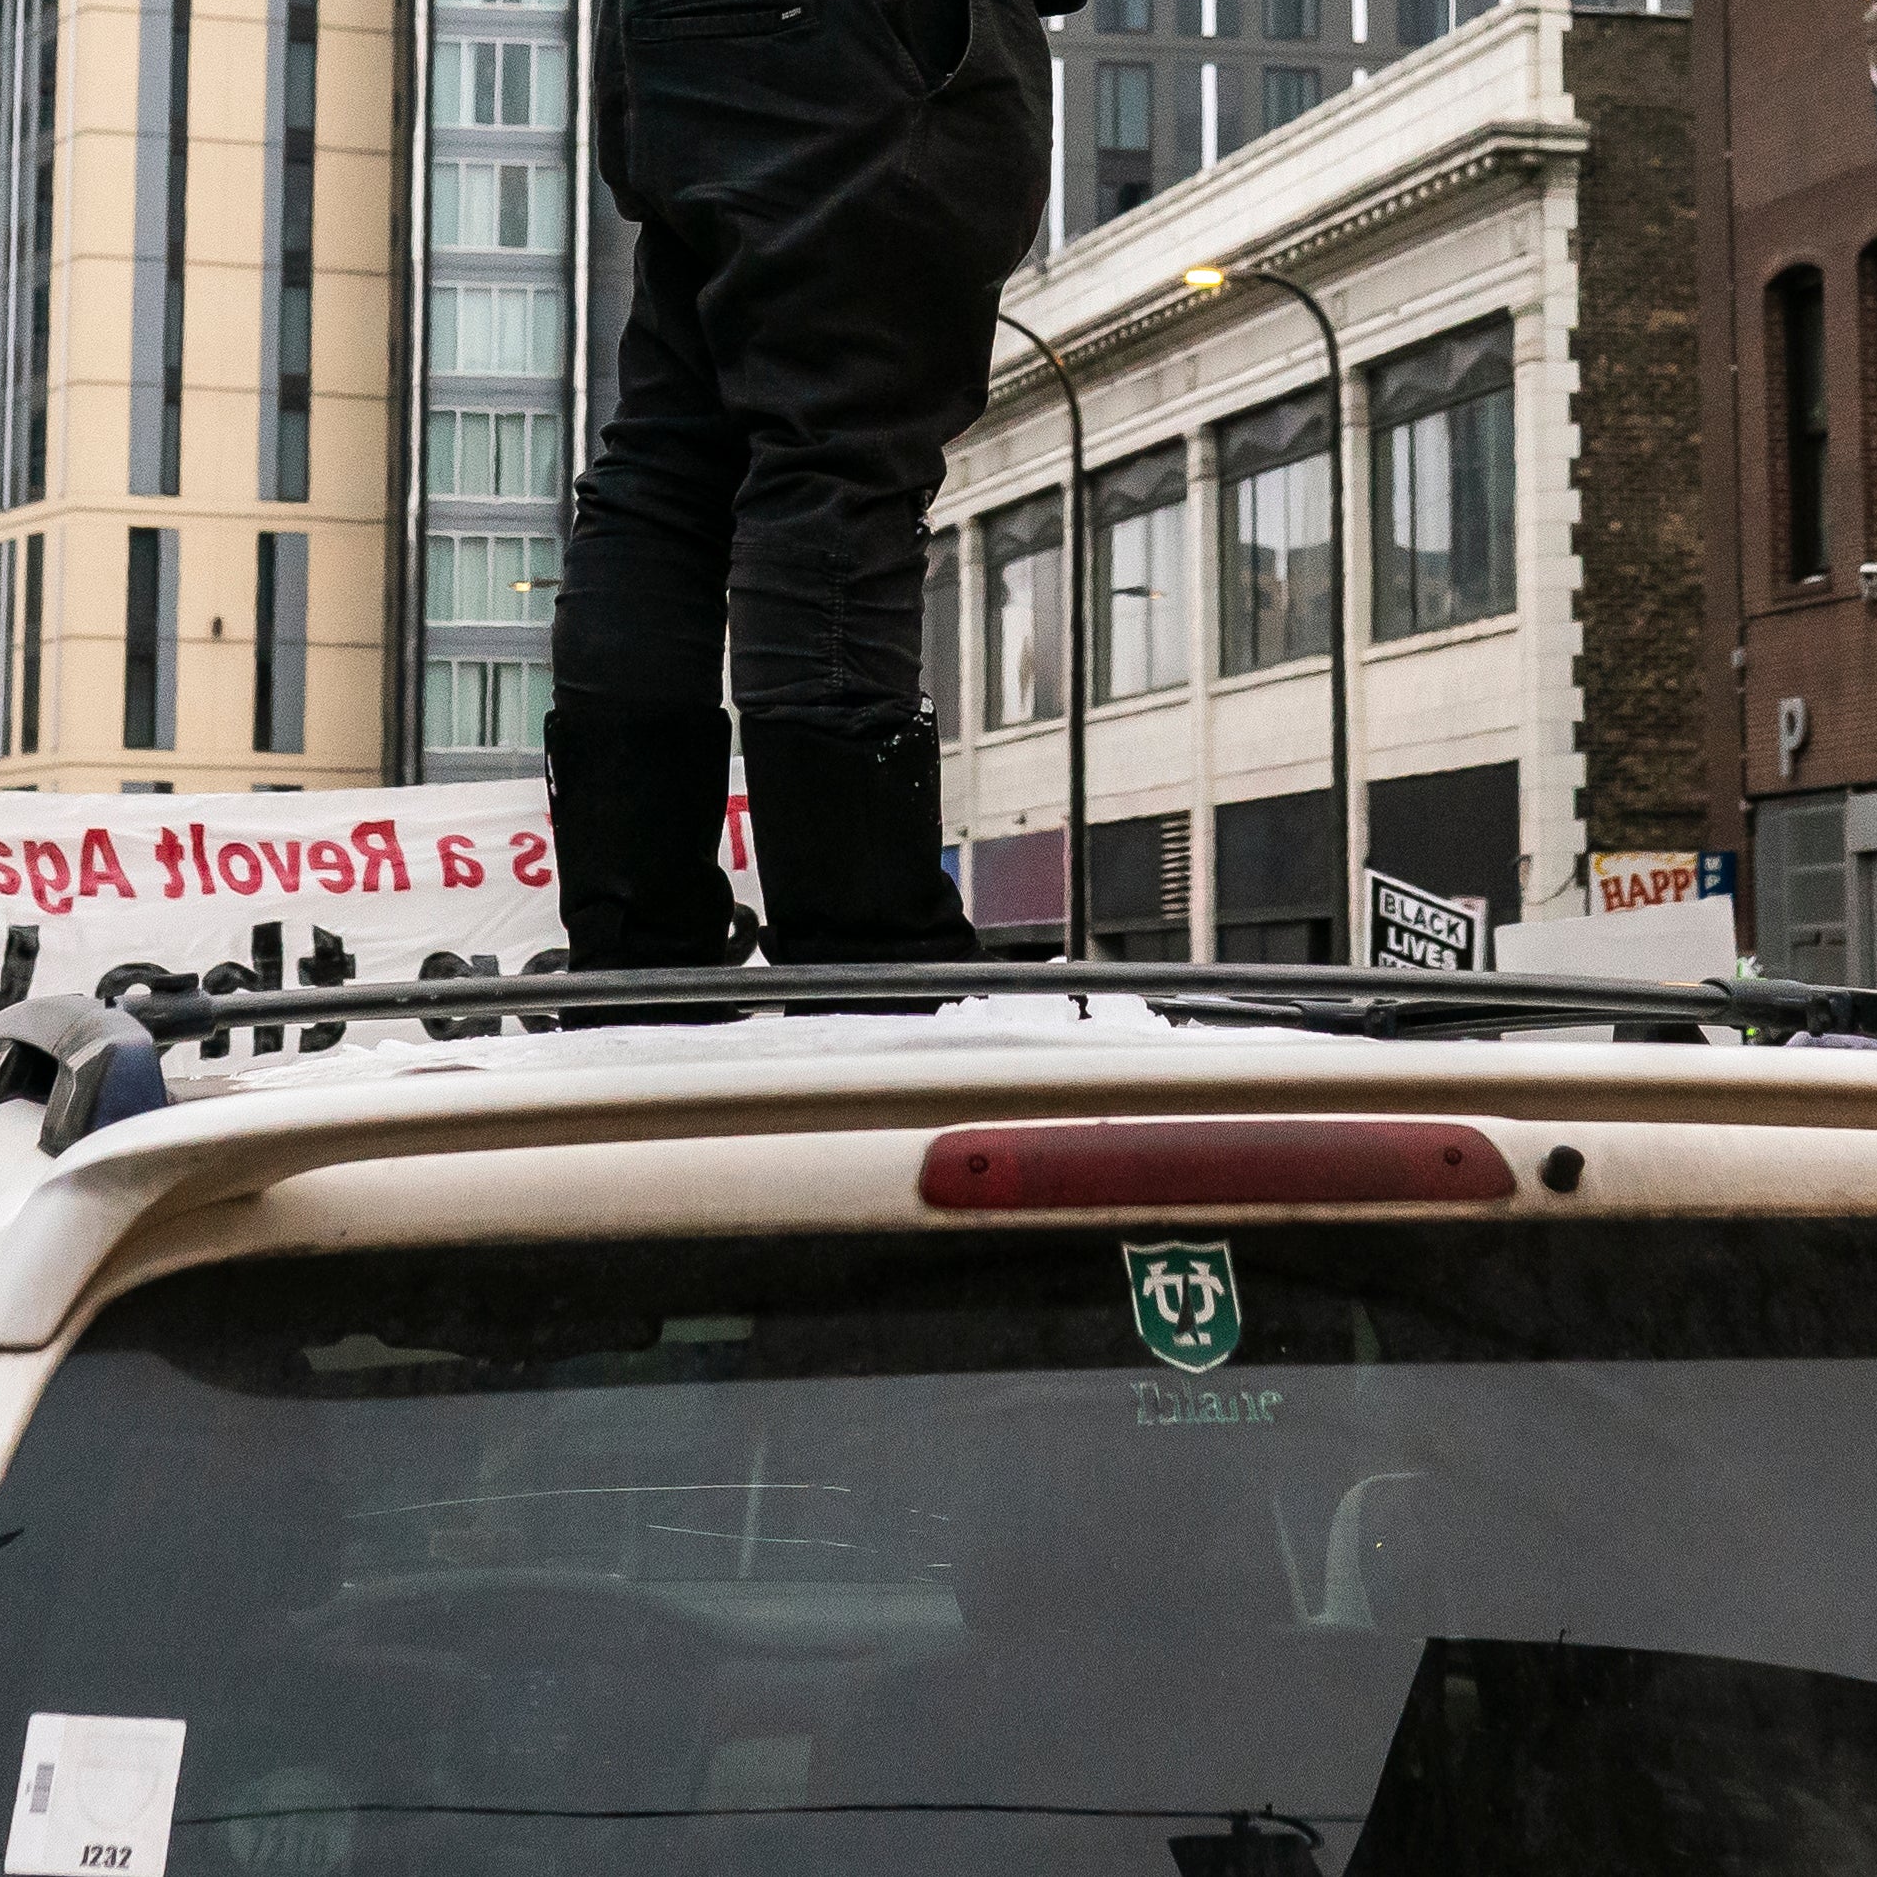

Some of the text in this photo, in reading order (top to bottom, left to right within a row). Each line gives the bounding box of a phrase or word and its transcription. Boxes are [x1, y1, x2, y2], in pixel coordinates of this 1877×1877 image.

[1599, 867, 1698, 914] HAPP
[1385, 891, 1462, 943] BLACK
[1387, 925, 1458, 972] LIVES
